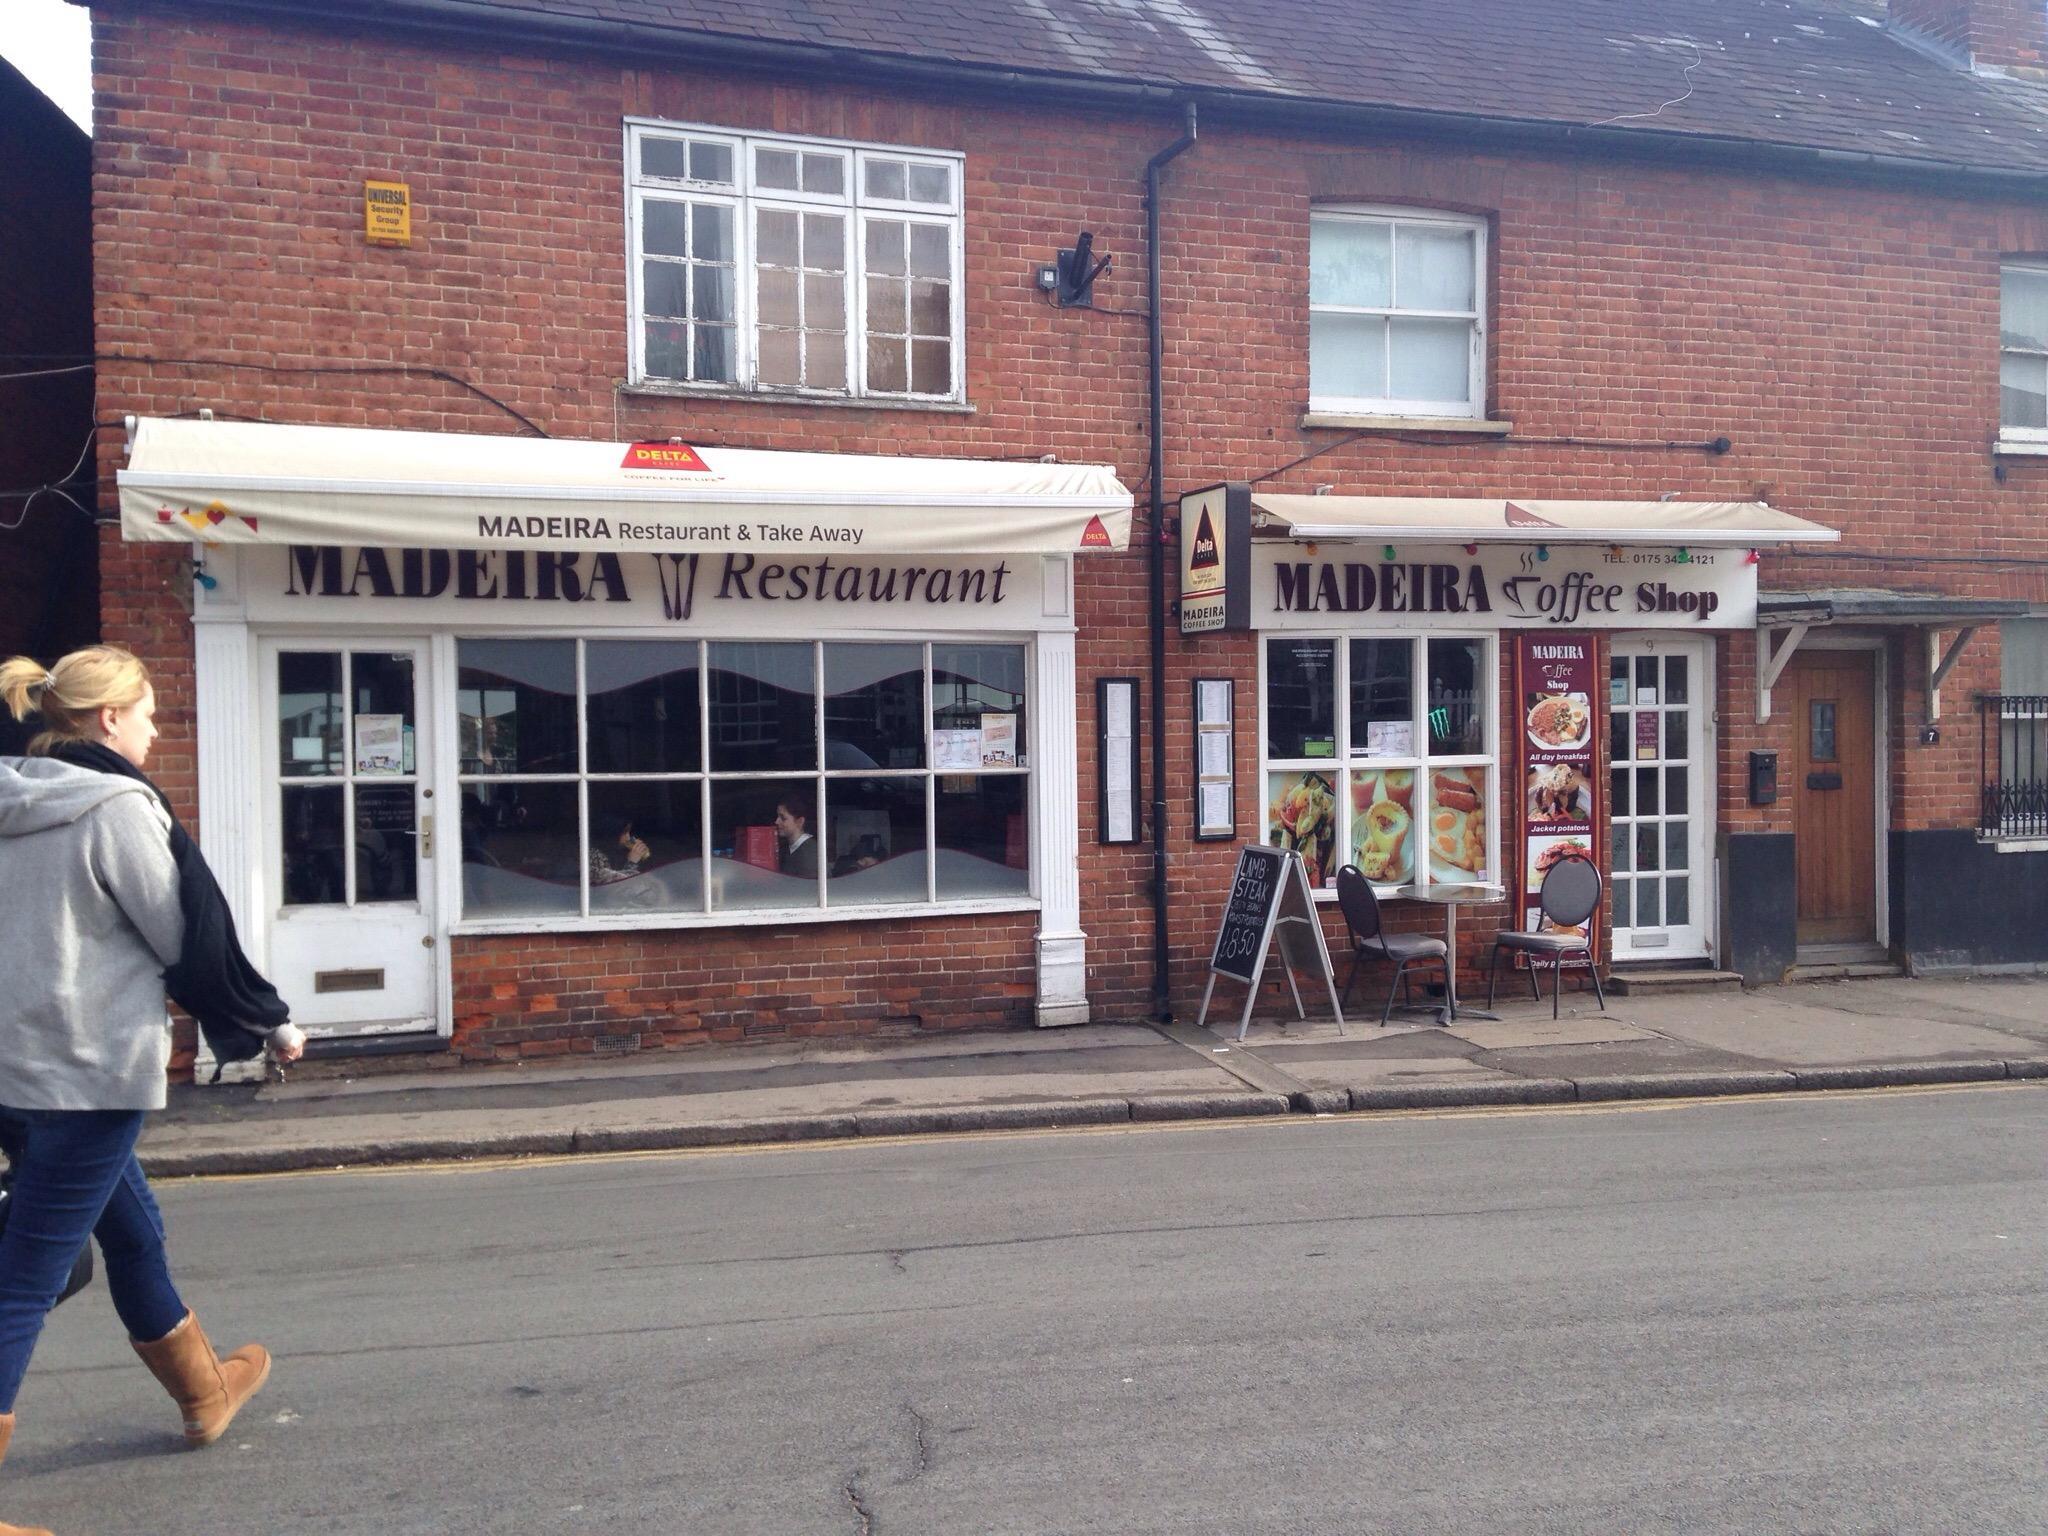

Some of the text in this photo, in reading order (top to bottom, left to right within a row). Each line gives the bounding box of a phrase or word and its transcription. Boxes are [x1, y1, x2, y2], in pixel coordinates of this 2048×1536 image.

[368, 188, 407, 206] UNIVERSAL
[371, 204, 403, 216] Security
[376, 215, 400, 226] Group
[635, 449, 693, 461] DELTA
[478, 515, 864, 545] MADEIRA Restaurant & Take Away
[1197, 539, 1214, 554] Delta
[1602, 553, 1629, 564] TEL:
[1633, 553, 1661, 564] 0175
[285, 543, 1011, 604] MADEIRA Restaurant
[1273, 562, 1493, 613] MADEIRA
[1636, 581, 1719, 621] Shop
[1183, 605, 1225, 621] MADEIRA
[1183, 618, 1225, 629] COFFEE SHOP
[1646, 639, 1654, 652] 9
[1532, 645, 1584, 660] MADEIRA
[1546, 679, 1569, 692] Shop
[1929, 732, 1935, 741] 7
[1530, 752, 1591, 762] All day breakfast
[1531, 824, 1590, 833] Jacket potatoes
[1240, 853, 1267, 880] LAMB
[1235, 876, 1270, 903] STEAK
